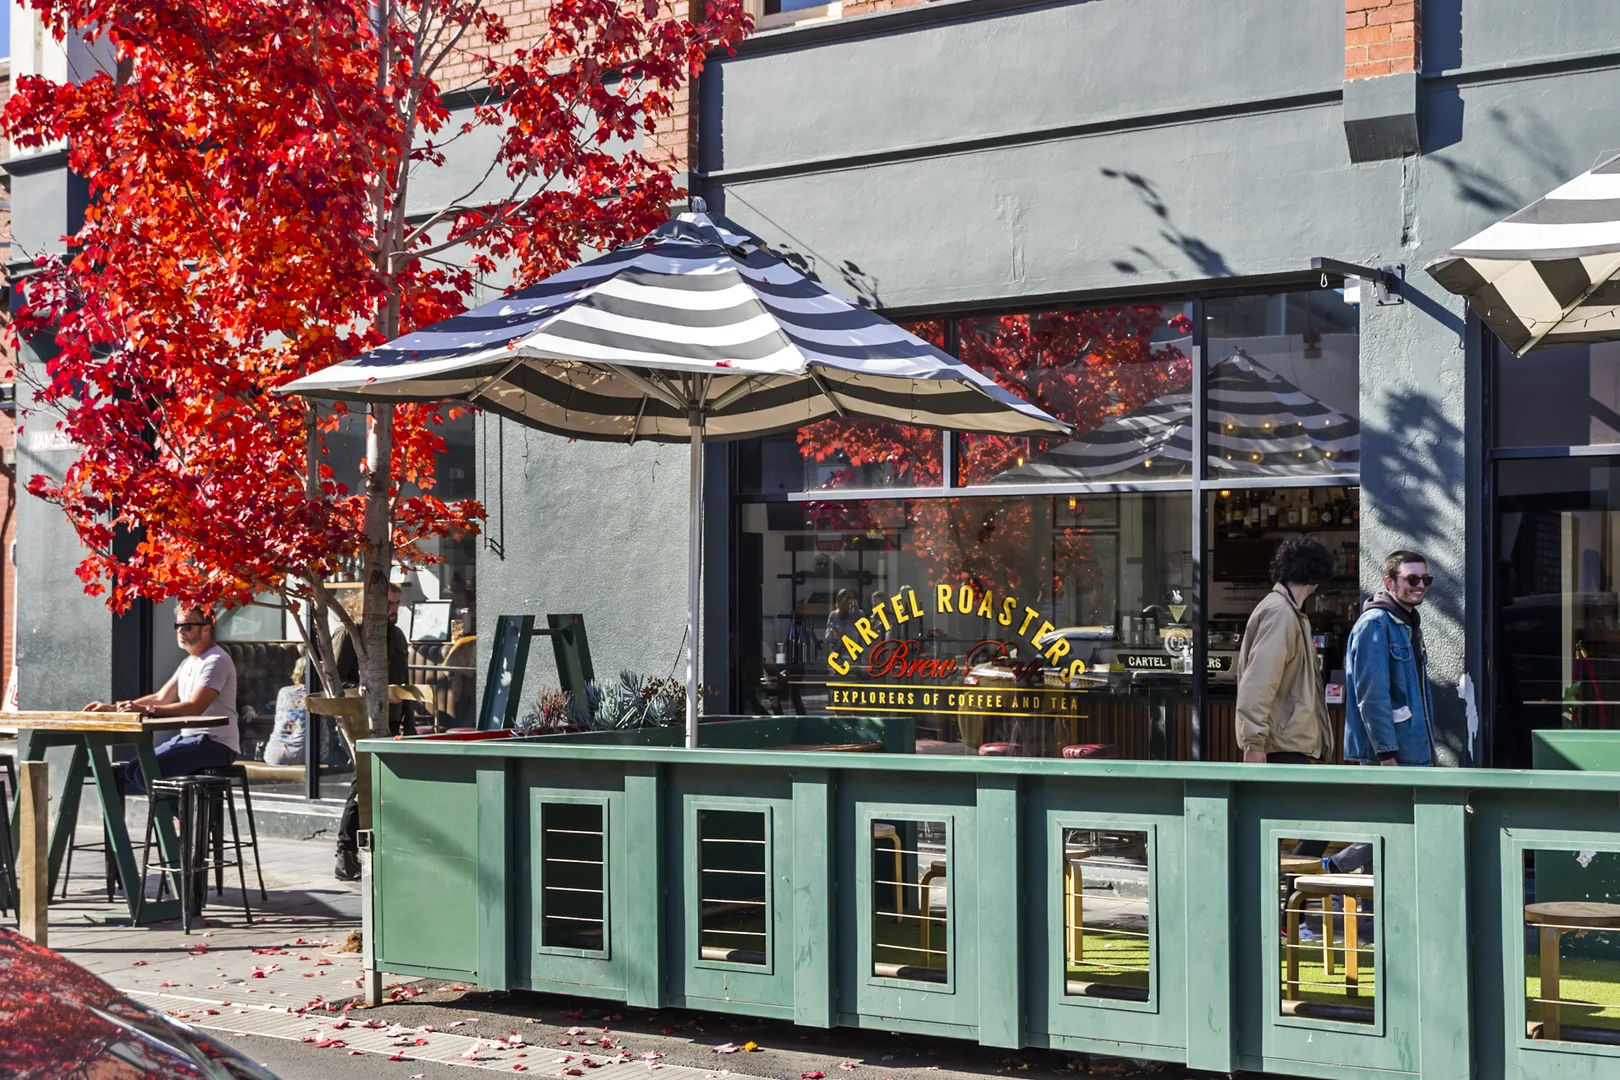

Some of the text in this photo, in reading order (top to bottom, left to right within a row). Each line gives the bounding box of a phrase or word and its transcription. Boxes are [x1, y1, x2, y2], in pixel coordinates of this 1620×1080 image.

[827, 583, 1086, 683] CARTEL ROASTERS
[867, 639, 1045, 682] Brew Bar
[1128, 656, 1167, 667] CARTEL
[833, 690, 1078, 711] EXPLORERS OF COFFEE AND TEA
